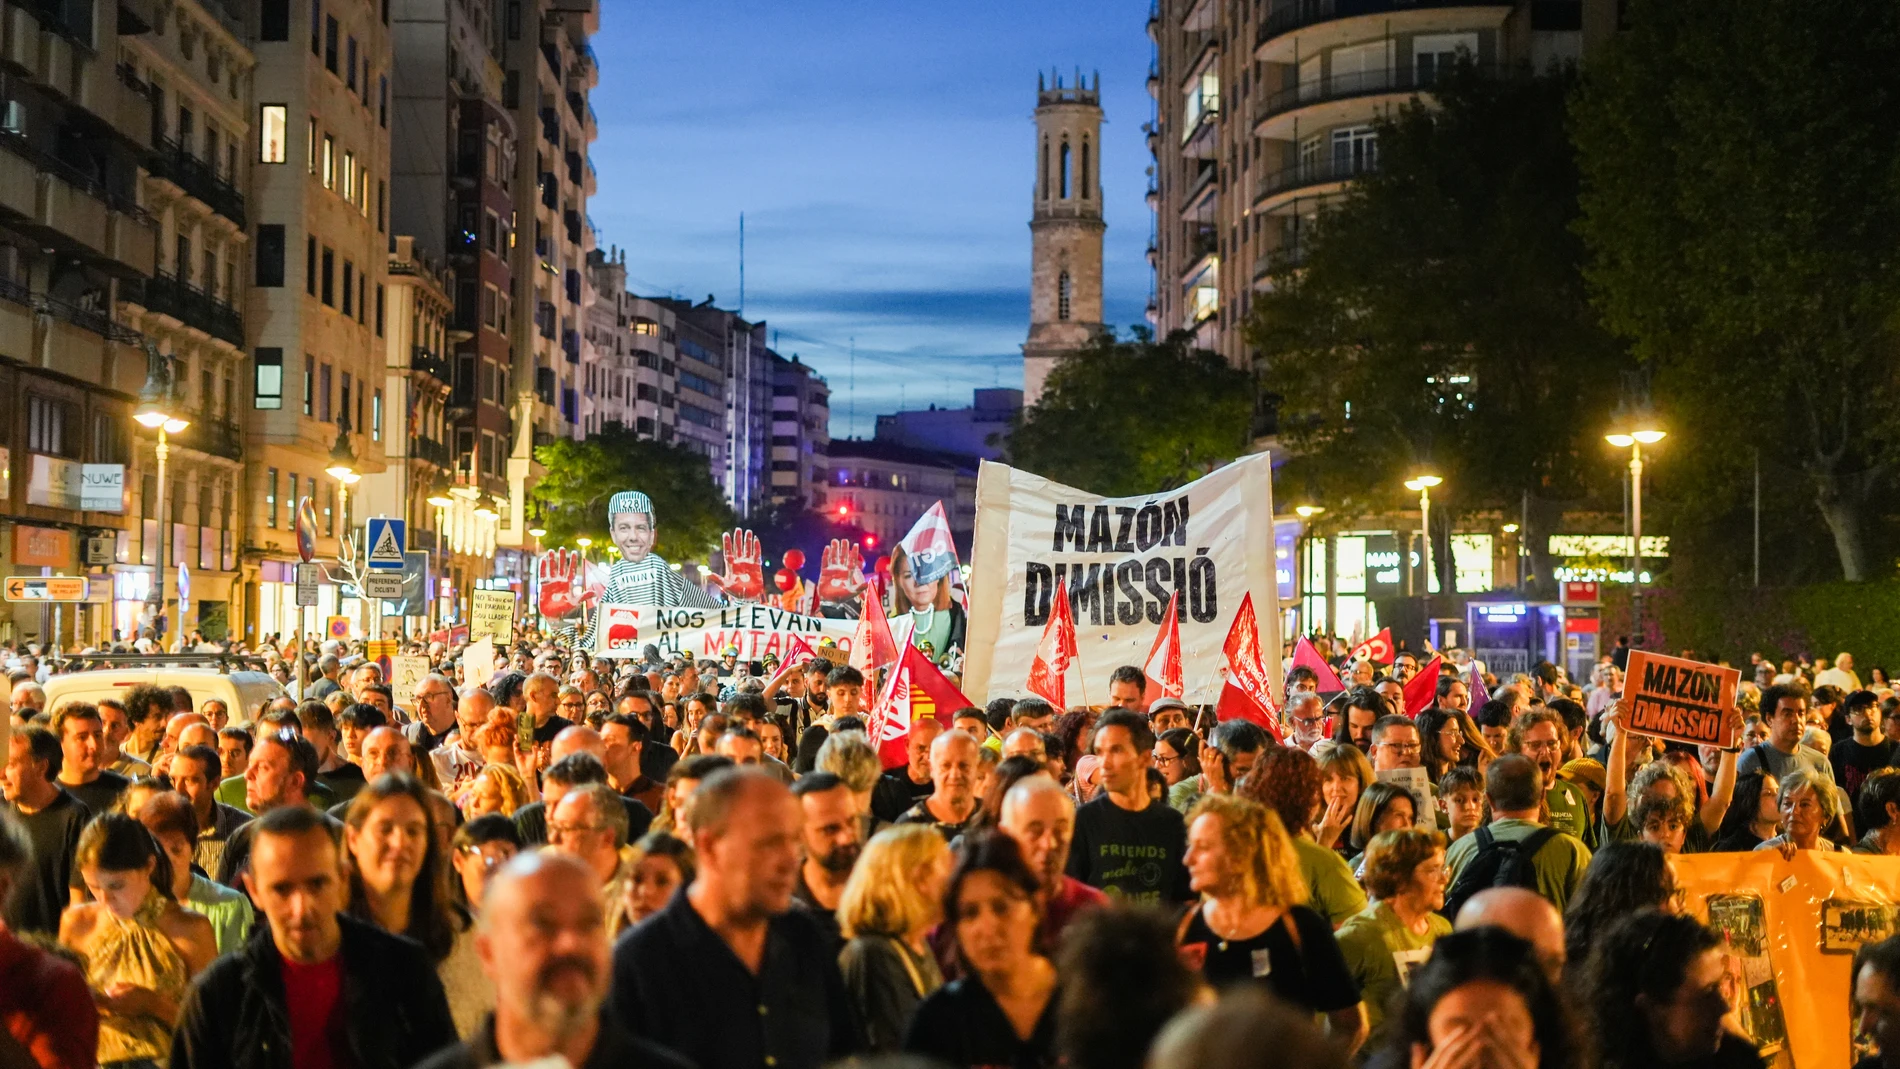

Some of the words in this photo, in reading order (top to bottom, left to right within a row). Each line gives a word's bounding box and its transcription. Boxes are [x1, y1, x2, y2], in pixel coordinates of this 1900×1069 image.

[81, 474, 121, 485] NUWE
[621, 500, 640, 509] 228
[1052, 495, 1190, 553] MAZÓN
[1366, 552, 1420, 568] MANO
[657, 609, 706, 630] NOS
[721, 606, 822, 632] LLEVAN
[610, 638, 638, 651] CGT
[821, 648, 835, 657] NO
[1643, 662, 1722, 704] MAZÓN
[1632, 700, 1720, 740] DIMISSIÓ
[1100, 844, 1167, 859] FRIENDS
